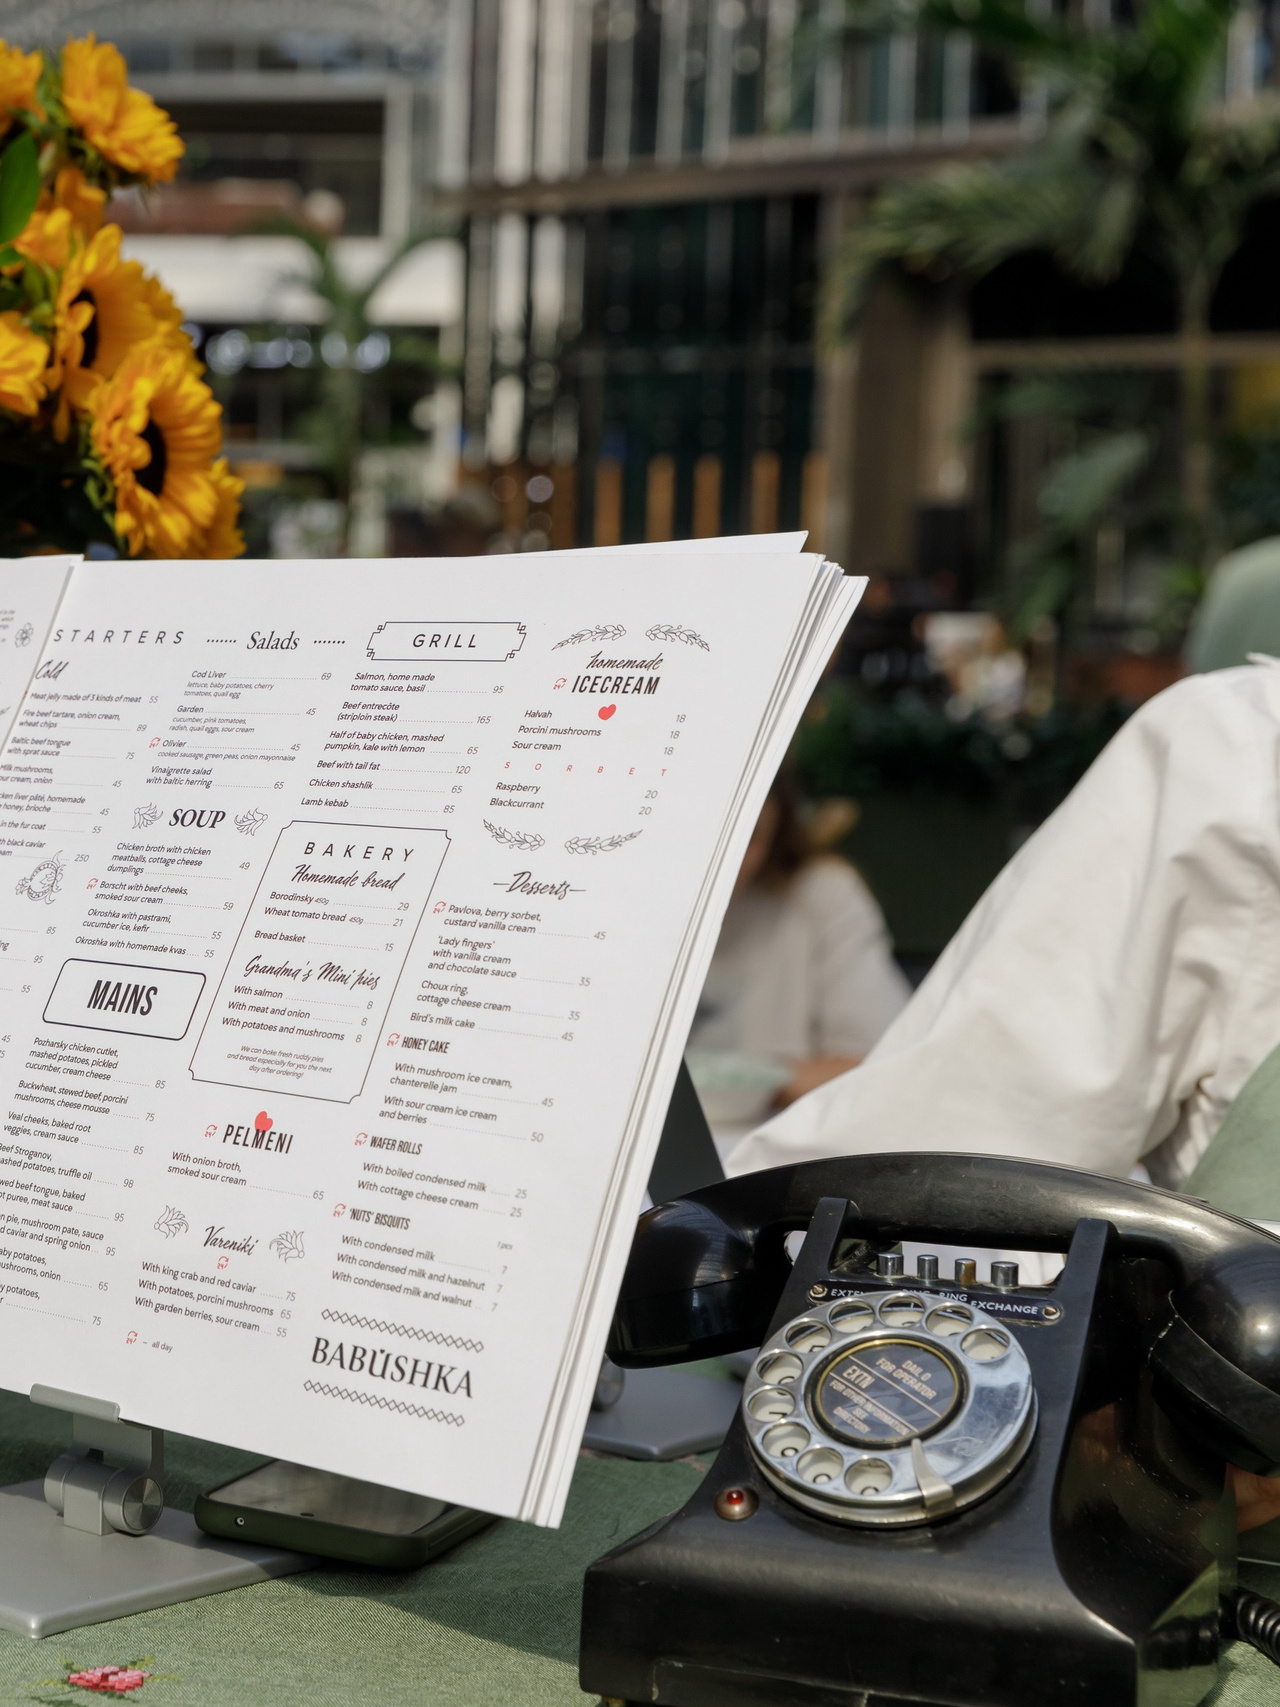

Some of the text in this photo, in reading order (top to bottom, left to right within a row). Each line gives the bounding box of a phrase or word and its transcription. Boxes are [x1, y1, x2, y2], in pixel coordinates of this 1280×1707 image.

[53, 629, 185, 645] STARTERS
[246, 630, 300, 651] Salads
[412, 633, 476, 649] GRILL
[34, 659, 70, 681] Cold
[585, 650, 664, 672] homemade
[191, 670, 333, 681] Cod Liver 69
[354, 672, 436, 682] Salmon, home made
[571, 675, 661, 695] ICECREAM
[350, 683, 505, 694] tomato sauce, basil 95
[176, 704, 317, 716] Garden 45
[341, 701, 401, 711] Beef entrecôte
[336, 711, 492, 725] (striploin steak) 165
[523, 709, 687, 724] Halvah 18
[517, 724, 681, 740] Porcini mushrooms 18
[162, 739, 302, 752] Olivier 45
[511, 740, 675, 756] Sour cream 18
[157, 750, 181, 758] cooked
[178, 752, 205, 760] sausage,
[203, 753, 224, 761] green
[222, 753, 240, 761] peas,
[258, 754, 297, 763] mayonnaise
[151, 765, 214, 776] Vinaigrette salad
[316, 759, 472, 775] Beef with tail fat 120
[145, 776, 285, 790] with baltic herring 65
[308, 778, 464, 794] Chicken shashlik 65
[495, 781, 659, 800] Raspberry 20
[489, 797, 653, 816] Blackcurrant 20
[168, 808, 227, 829] SOUP
[303, 841, 415, 862] BAKERY
[290, 863, 406, 892] Homemade bread
[269, 891, 315, 905] Borodinsky
[396, 901, 410, 912] 29
[264, 906, 292, 917] Wheat
[291, 909, 321, 920] tomato
[321, 911, 348, 922] bread
[392, 917, 404, 927] 21
[74, 935, 216, 959] Okroshka with homemade kvas 55
[253, 929, 395, 953] Bread basket 15
[243, 954, 381, 991] Grandma's Mini pies
[86, 979, 159, 1017] MAINS
[233, 984, 374, 1010] With salmon 8
[409, 1011, 574, 1042] Bird's milk cake 45
[401, 1036, 451, 1054] HONEY CAKE
[222, 1123, 294, 1155] PELMENI
[369, 1135, 423, 1156] WAFER ROLLS
[13, 1145, 53, 1162] Stroganov,
[172, 1151, 242, 1174] With onion broth,
[373, 1212, 411, 1231] BISQUITS
[203, 1225, 260, 1256] Vareniki
[141, 1261, 297, 1302] With king crab and red caviar 75
[970, 1300, 1039, 1315] EXCHANGE
[842, 1365, 876, 1389] EXTN
[875, 1357, 938, 1400] FOR OPERATOR
